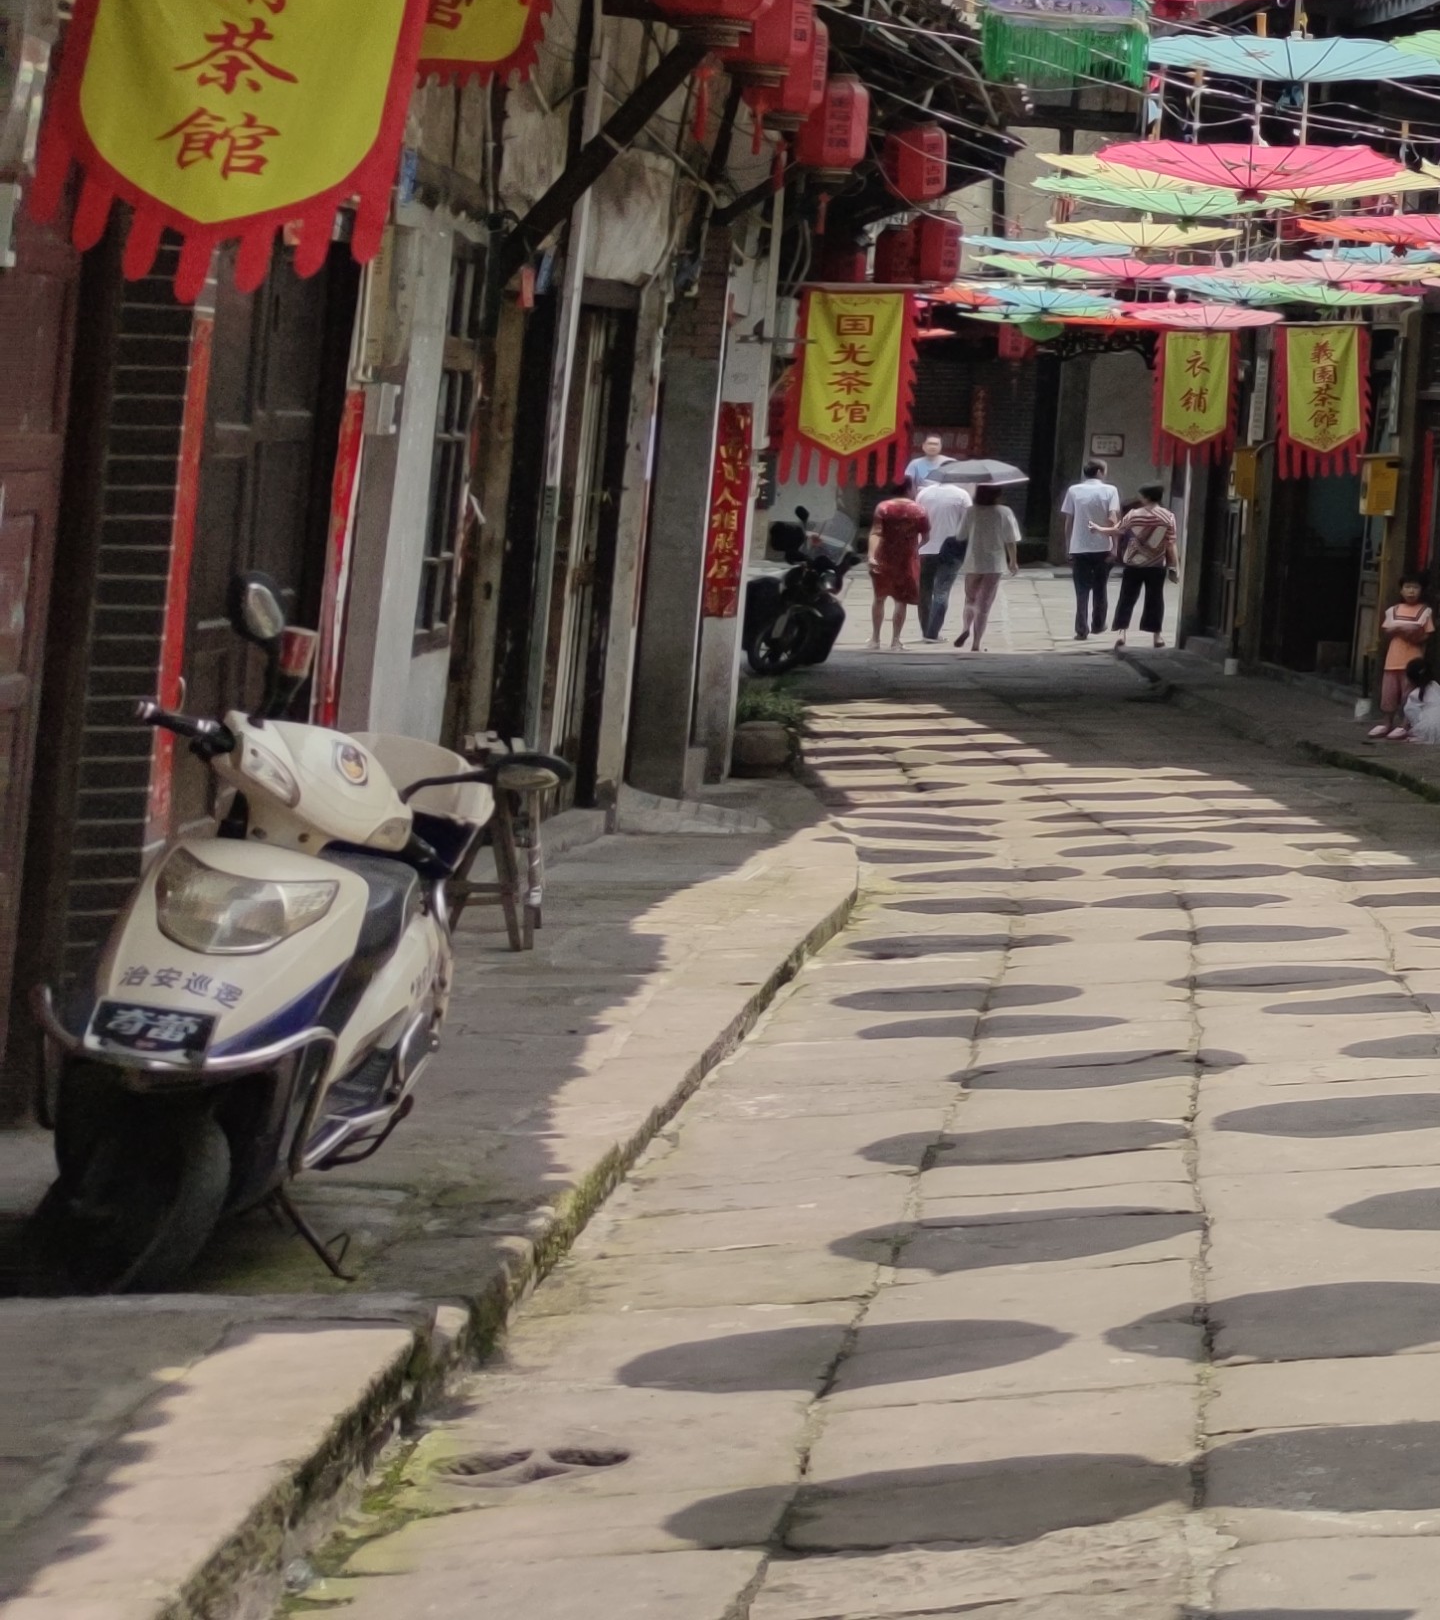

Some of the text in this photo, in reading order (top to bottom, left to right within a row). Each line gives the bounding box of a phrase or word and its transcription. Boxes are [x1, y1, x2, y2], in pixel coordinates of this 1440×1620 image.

[825, 314, 876, 424] 国光茶馆
[1306, 341, 1342, 430] 義園茶館
